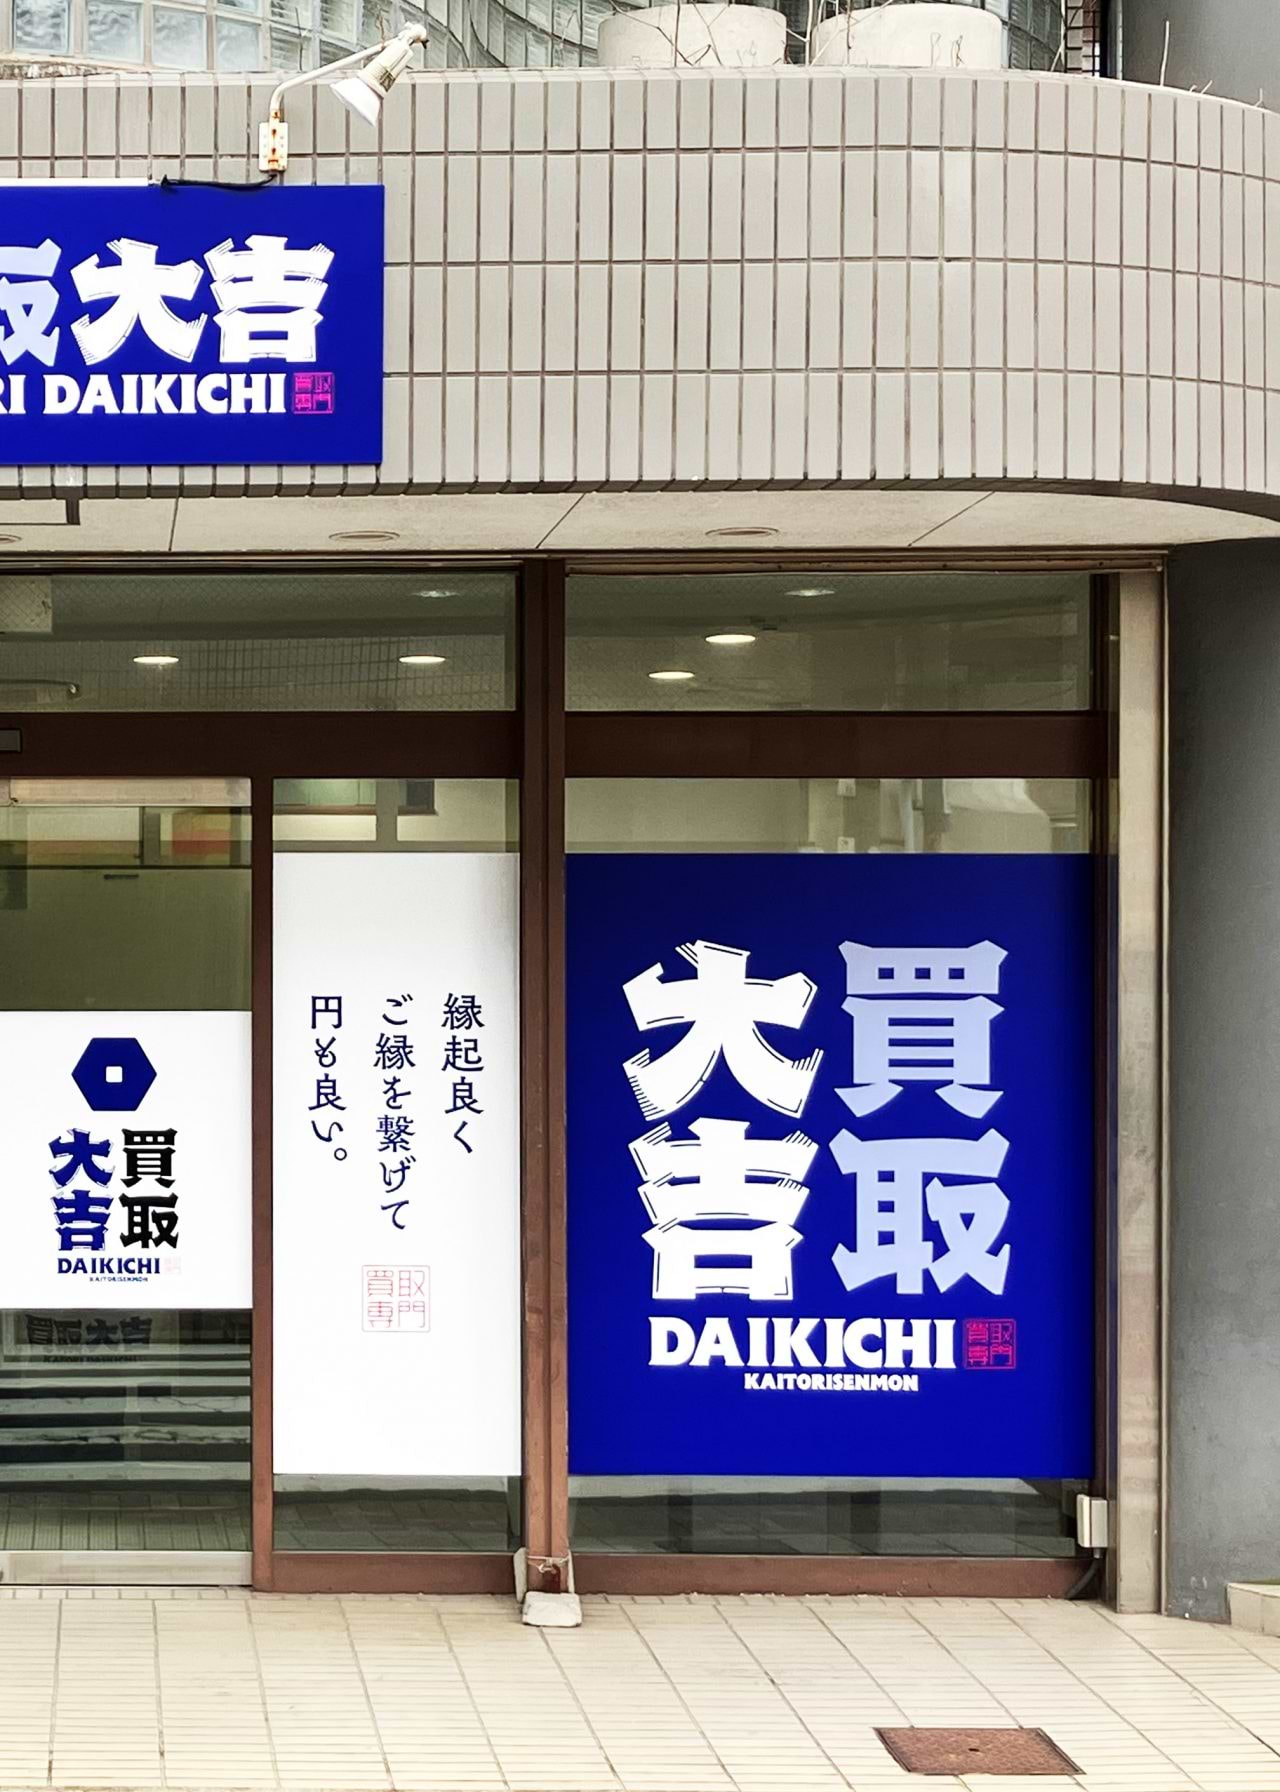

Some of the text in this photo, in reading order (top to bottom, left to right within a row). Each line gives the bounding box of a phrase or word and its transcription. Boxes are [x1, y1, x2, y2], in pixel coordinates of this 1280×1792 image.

[42, 372, 287, 415] DAIKICHI
[307, 995, 348, 1162] 円も良い。
[373, 993, 417, 1230] ご縁を繋げて
[440, 992, 486, 1154] 縁起良く
[622, 939, 824, 1301] 大吉
[828, 939, 1011, 1296] 買取
[48, 1127, 115, 1252] 大吉
[118, 1127, 179, 1249] 買取
[57, 1257, 161, 1275] DAIKICHI
[649, 1316, 957, 1369] DAIKICHI
[744, 1372, 919, 1392] KAITORISENMON
